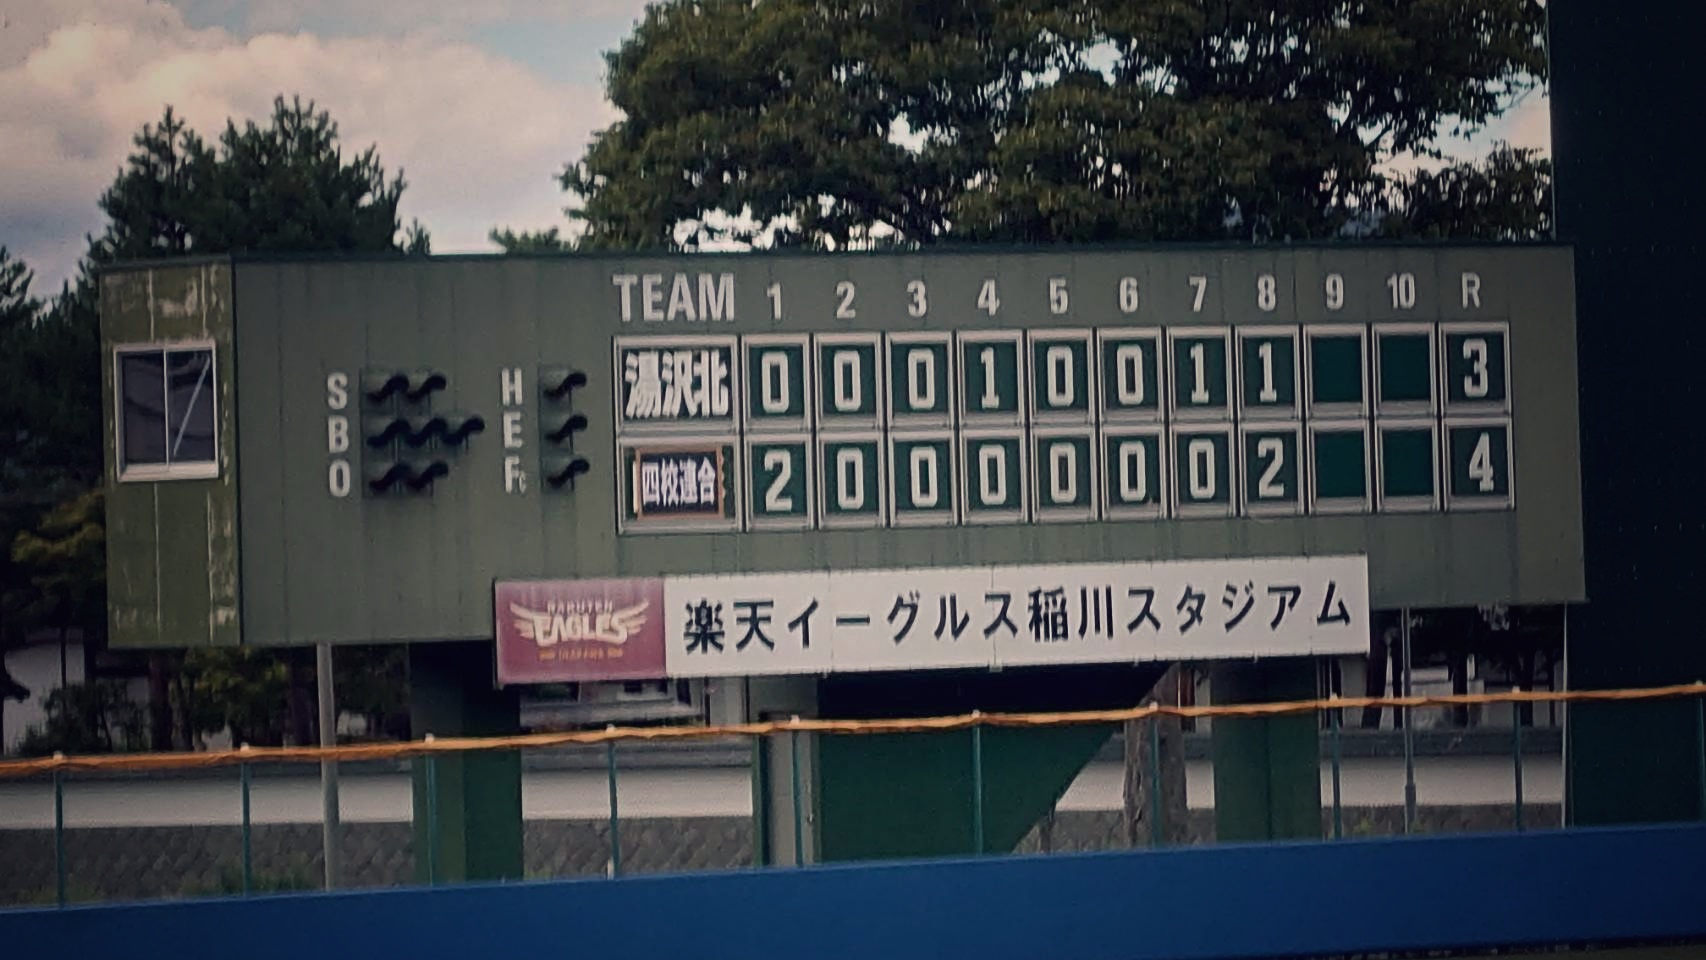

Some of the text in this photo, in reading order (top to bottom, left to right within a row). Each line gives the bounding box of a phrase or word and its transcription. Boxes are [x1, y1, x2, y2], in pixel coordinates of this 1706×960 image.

[612, 272, 1481, 322] TEAM 1 2 3 4 5 6 7 8 9 10 R
[327, 372, 348, 410] S
[501, 367, 523, 406] H
[624, 338, 1488, 418] 湯沢北 0 0 0 1 0 0 1 1 3
[328, 415, 349, 453] B
[503, 411, 523, 449] E
[329, 458, 351, 498] O
[641, 431, 1494, 512] 四校連合 2 0 0 0 0 0 0 2 4
[533, 613, 628, 647] EAGLES
[682, 581, 1351, 656] 楽天イーグルス稲川スタジアム
